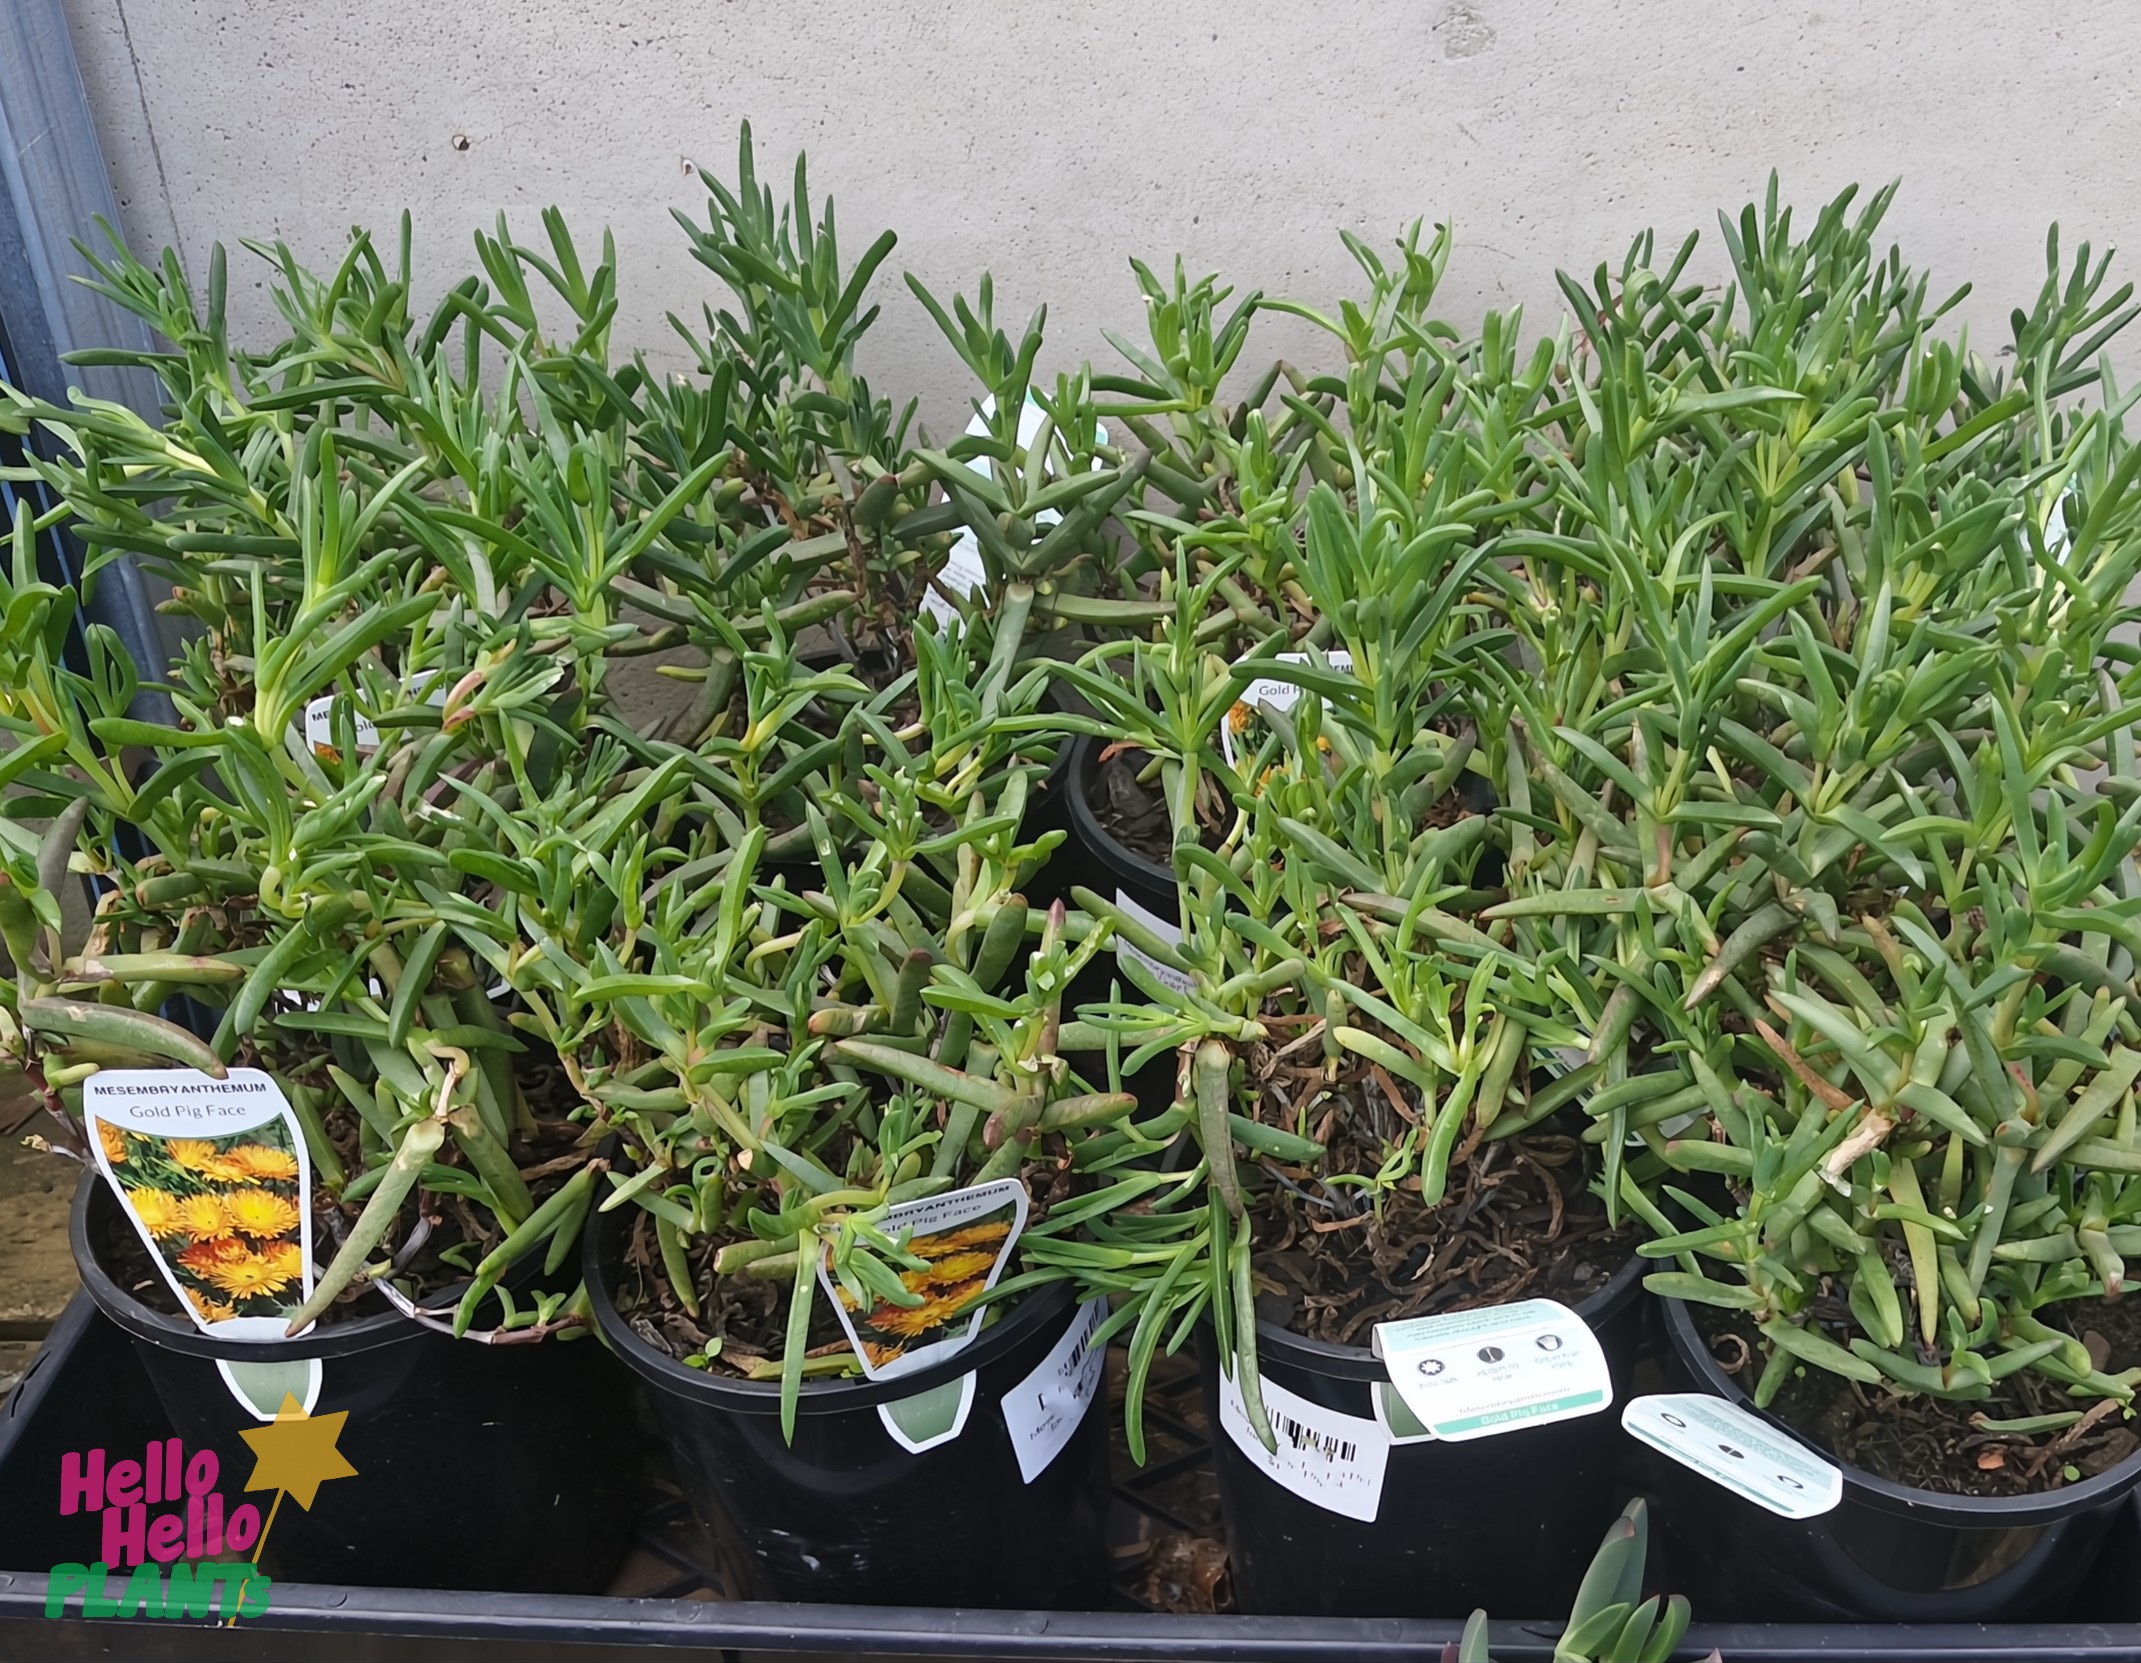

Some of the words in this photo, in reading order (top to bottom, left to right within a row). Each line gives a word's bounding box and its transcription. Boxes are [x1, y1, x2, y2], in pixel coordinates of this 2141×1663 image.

[1258, 685, 1290, 696] Gold
[94, 1083, 267, 1096] MESEMBRYANTHEMUM
[129, 1105, 171, 1118] Gold
[175, 1105, 203, 1119] Pig
[205, 1104, 246, 1117] Face
[884, 1185, 1010, 1221] MBRYANTHEMUM
[881, 1222, 908, 1234] old
